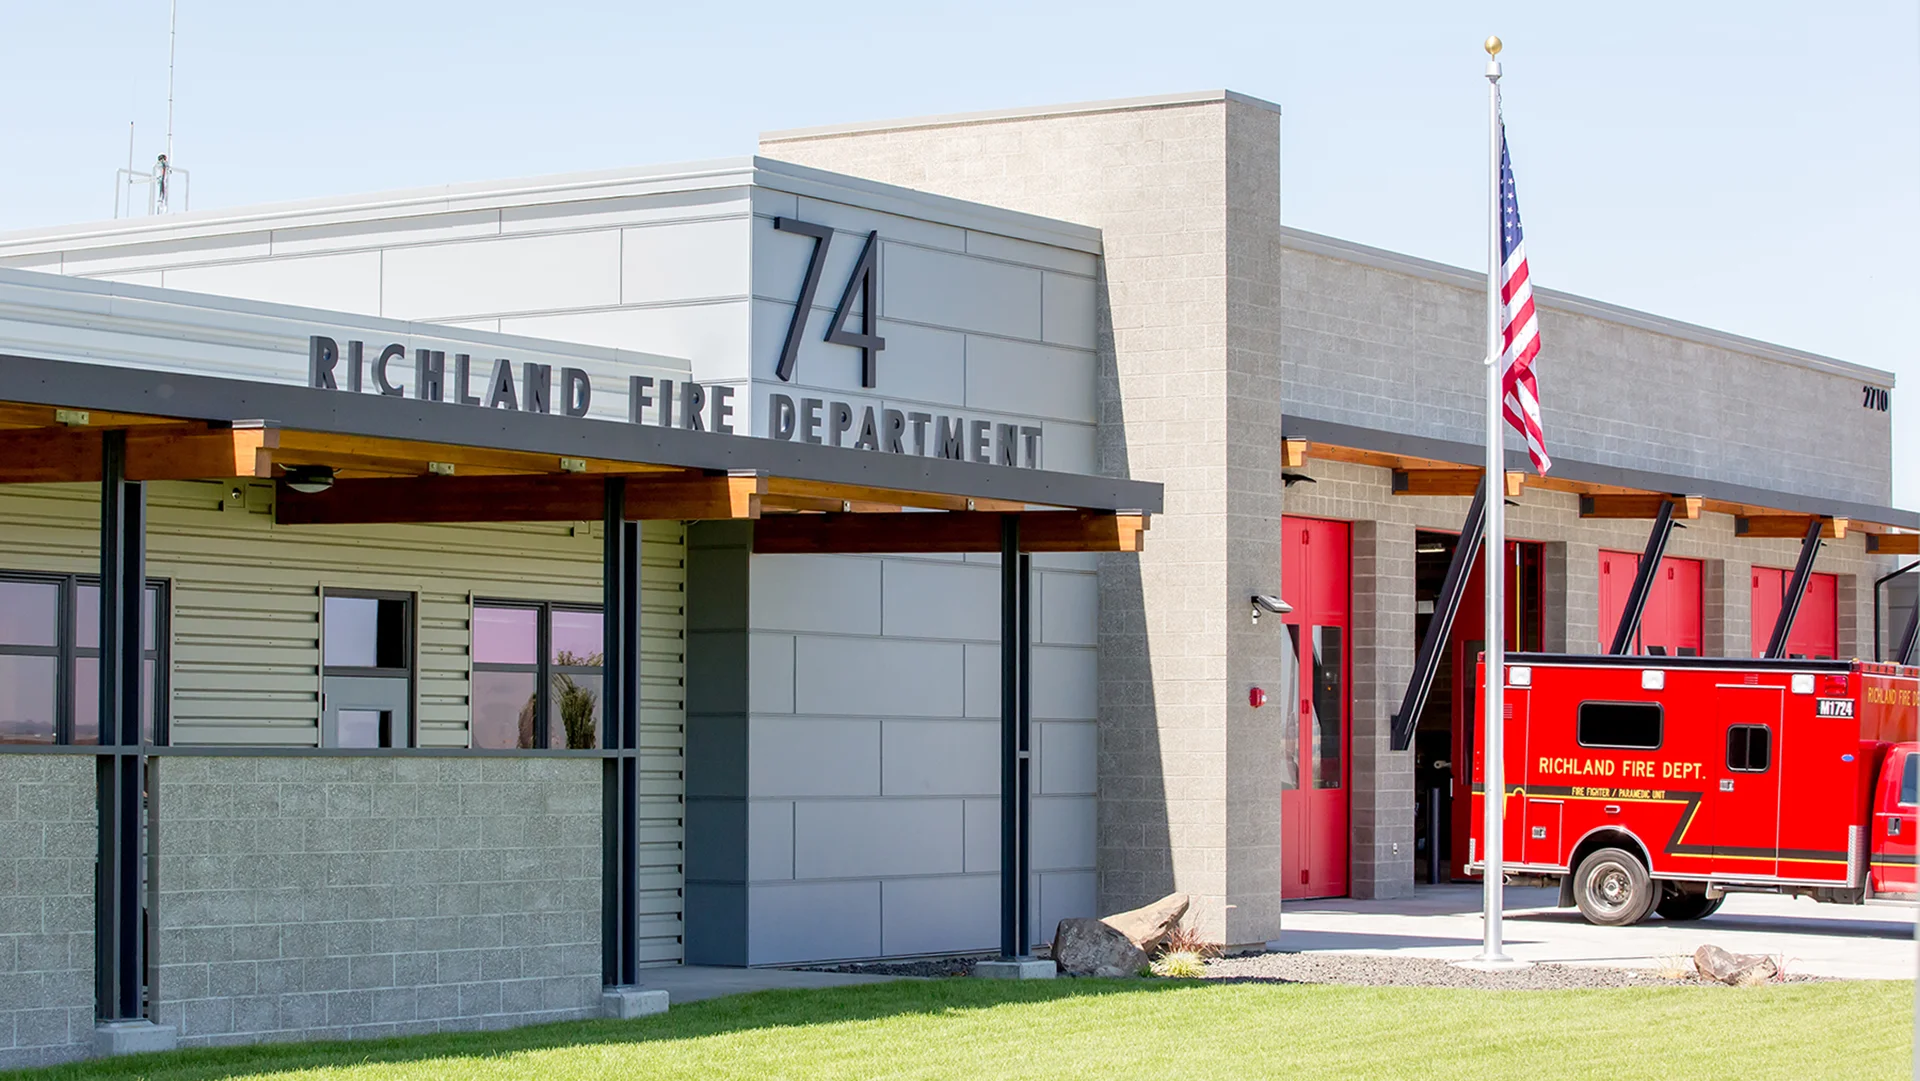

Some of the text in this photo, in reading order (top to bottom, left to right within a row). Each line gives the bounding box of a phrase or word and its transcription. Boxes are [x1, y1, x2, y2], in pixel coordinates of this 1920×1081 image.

[774, 216, 885, 388] 74
[308, 335, 1042, 469] RICHLAND FIRE DEPARTMENT
[1863, 385, 1888, 412] 2710
[1820, 700, 1853, 716] M1724
[1539, 757, 1707, 780] RICHLAND FIRE DEPT.
[1571, 786, 1585, 796] FIRE
[1586, 787, 1611, 797] FIGHTER
[1618, 788, 1651, 799] PARAMEDIC
[1652, 790, 1666, 799] UNIT
